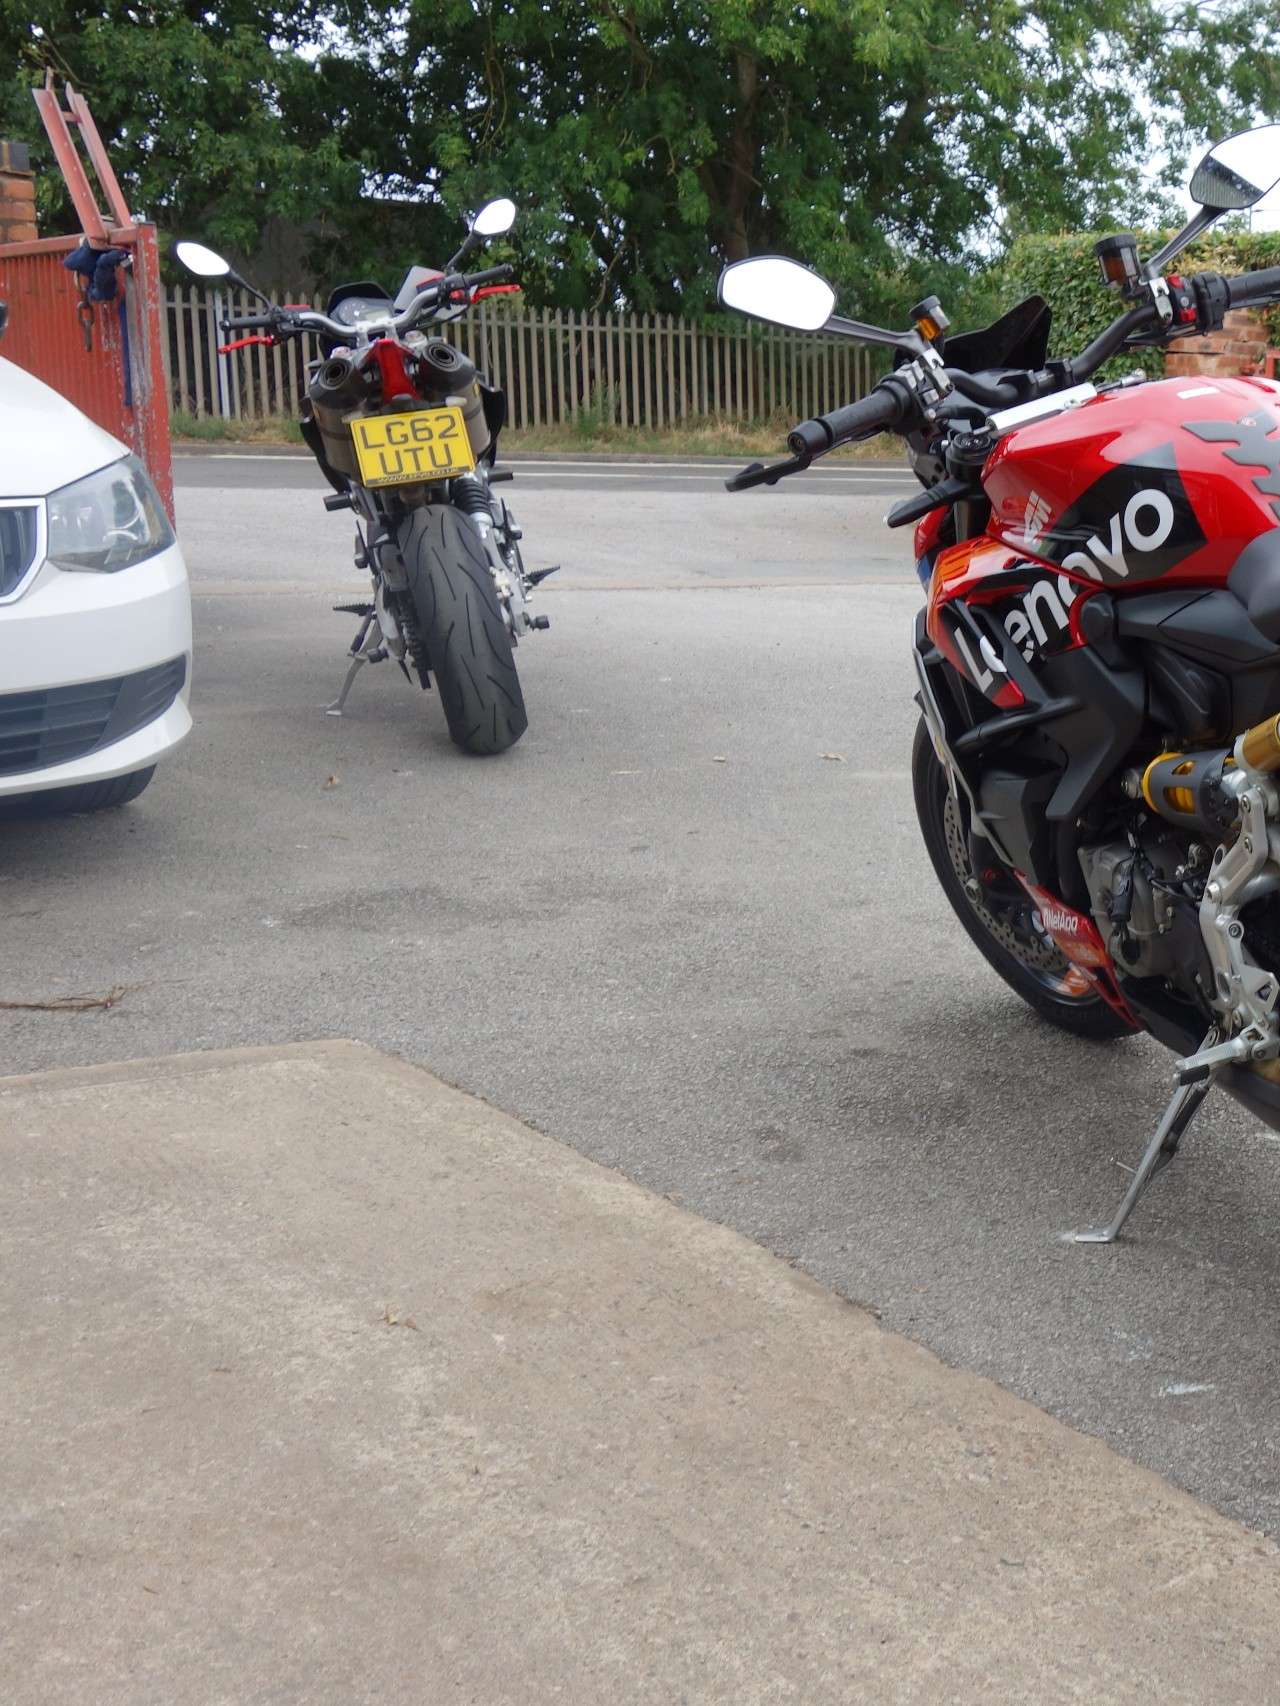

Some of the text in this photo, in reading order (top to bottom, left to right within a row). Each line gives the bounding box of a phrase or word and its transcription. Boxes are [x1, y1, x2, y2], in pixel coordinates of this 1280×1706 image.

[360, 414, 459, 450] LG62
[379, 443, 453, 475] UTU
[953, 488, 1175, 693] Lenovo
